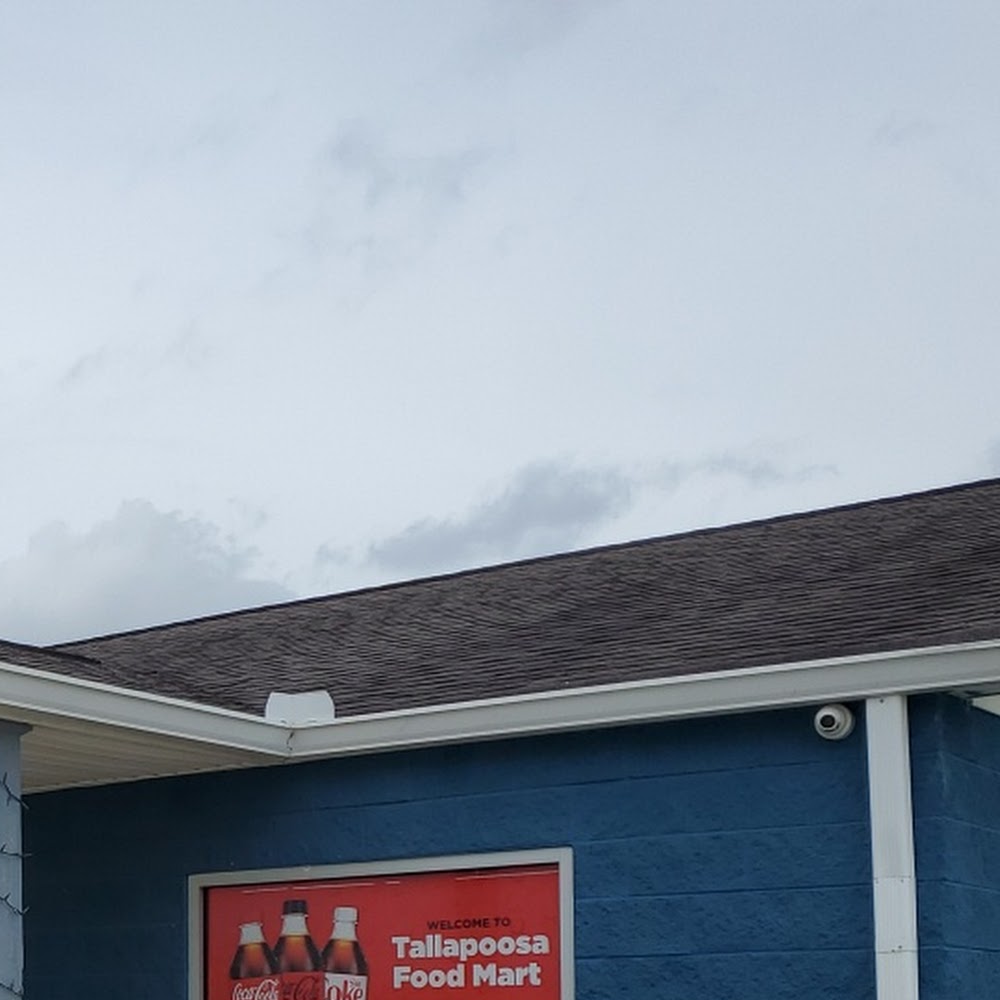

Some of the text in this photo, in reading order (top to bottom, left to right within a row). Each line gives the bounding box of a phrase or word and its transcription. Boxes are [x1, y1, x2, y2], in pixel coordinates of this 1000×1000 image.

[427, 917, 511, 930] WELCOME TO
[391, 933, 550, 962] Tallapoosa
[393, 962, 542, 989] Food Mart
